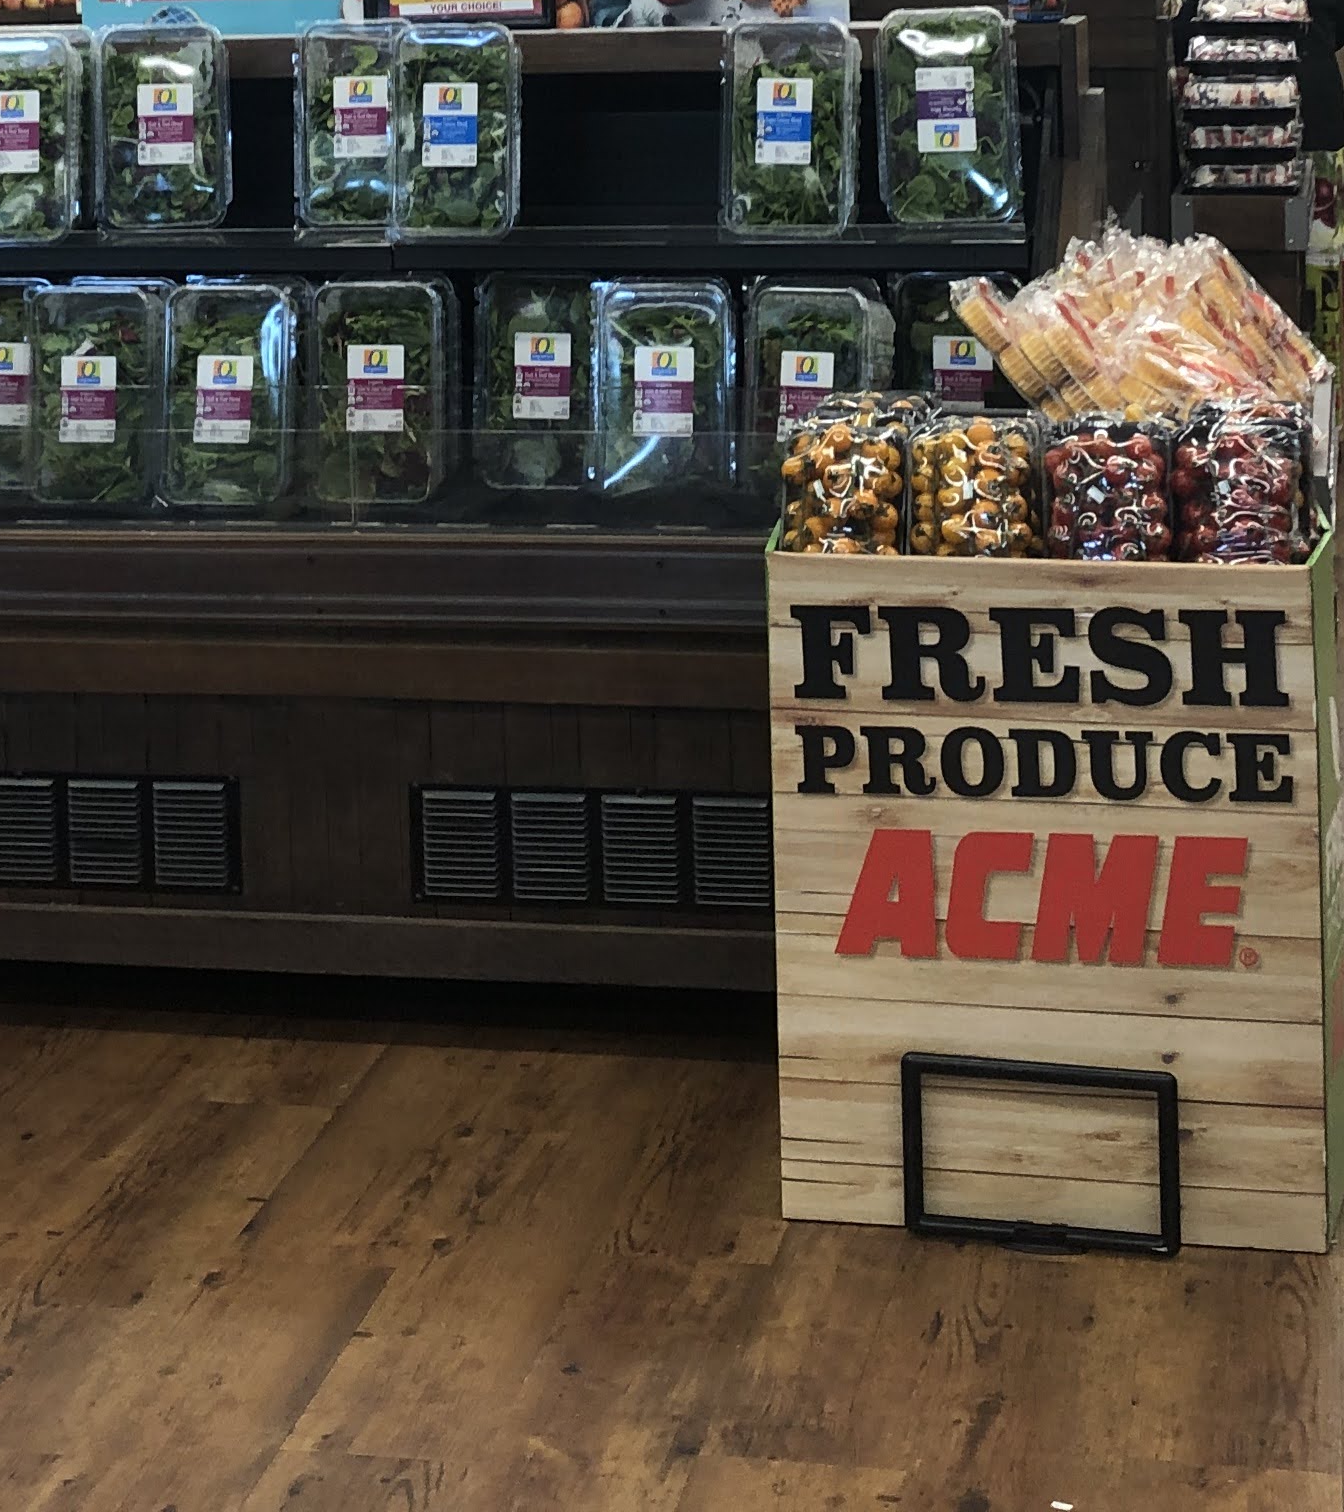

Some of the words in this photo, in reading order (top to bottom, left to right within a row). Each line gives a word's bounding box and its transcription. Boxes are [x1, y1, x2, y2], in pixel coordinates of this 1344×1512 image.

[430, 3, 458, 13] YOUR
[460, 1, 502, 13] CHOICE!
[790, 604, 1290, 708] FRESH
[796, 726, 1294, 804] PRODUCE
[835, 828, 1248, 968] ACME
